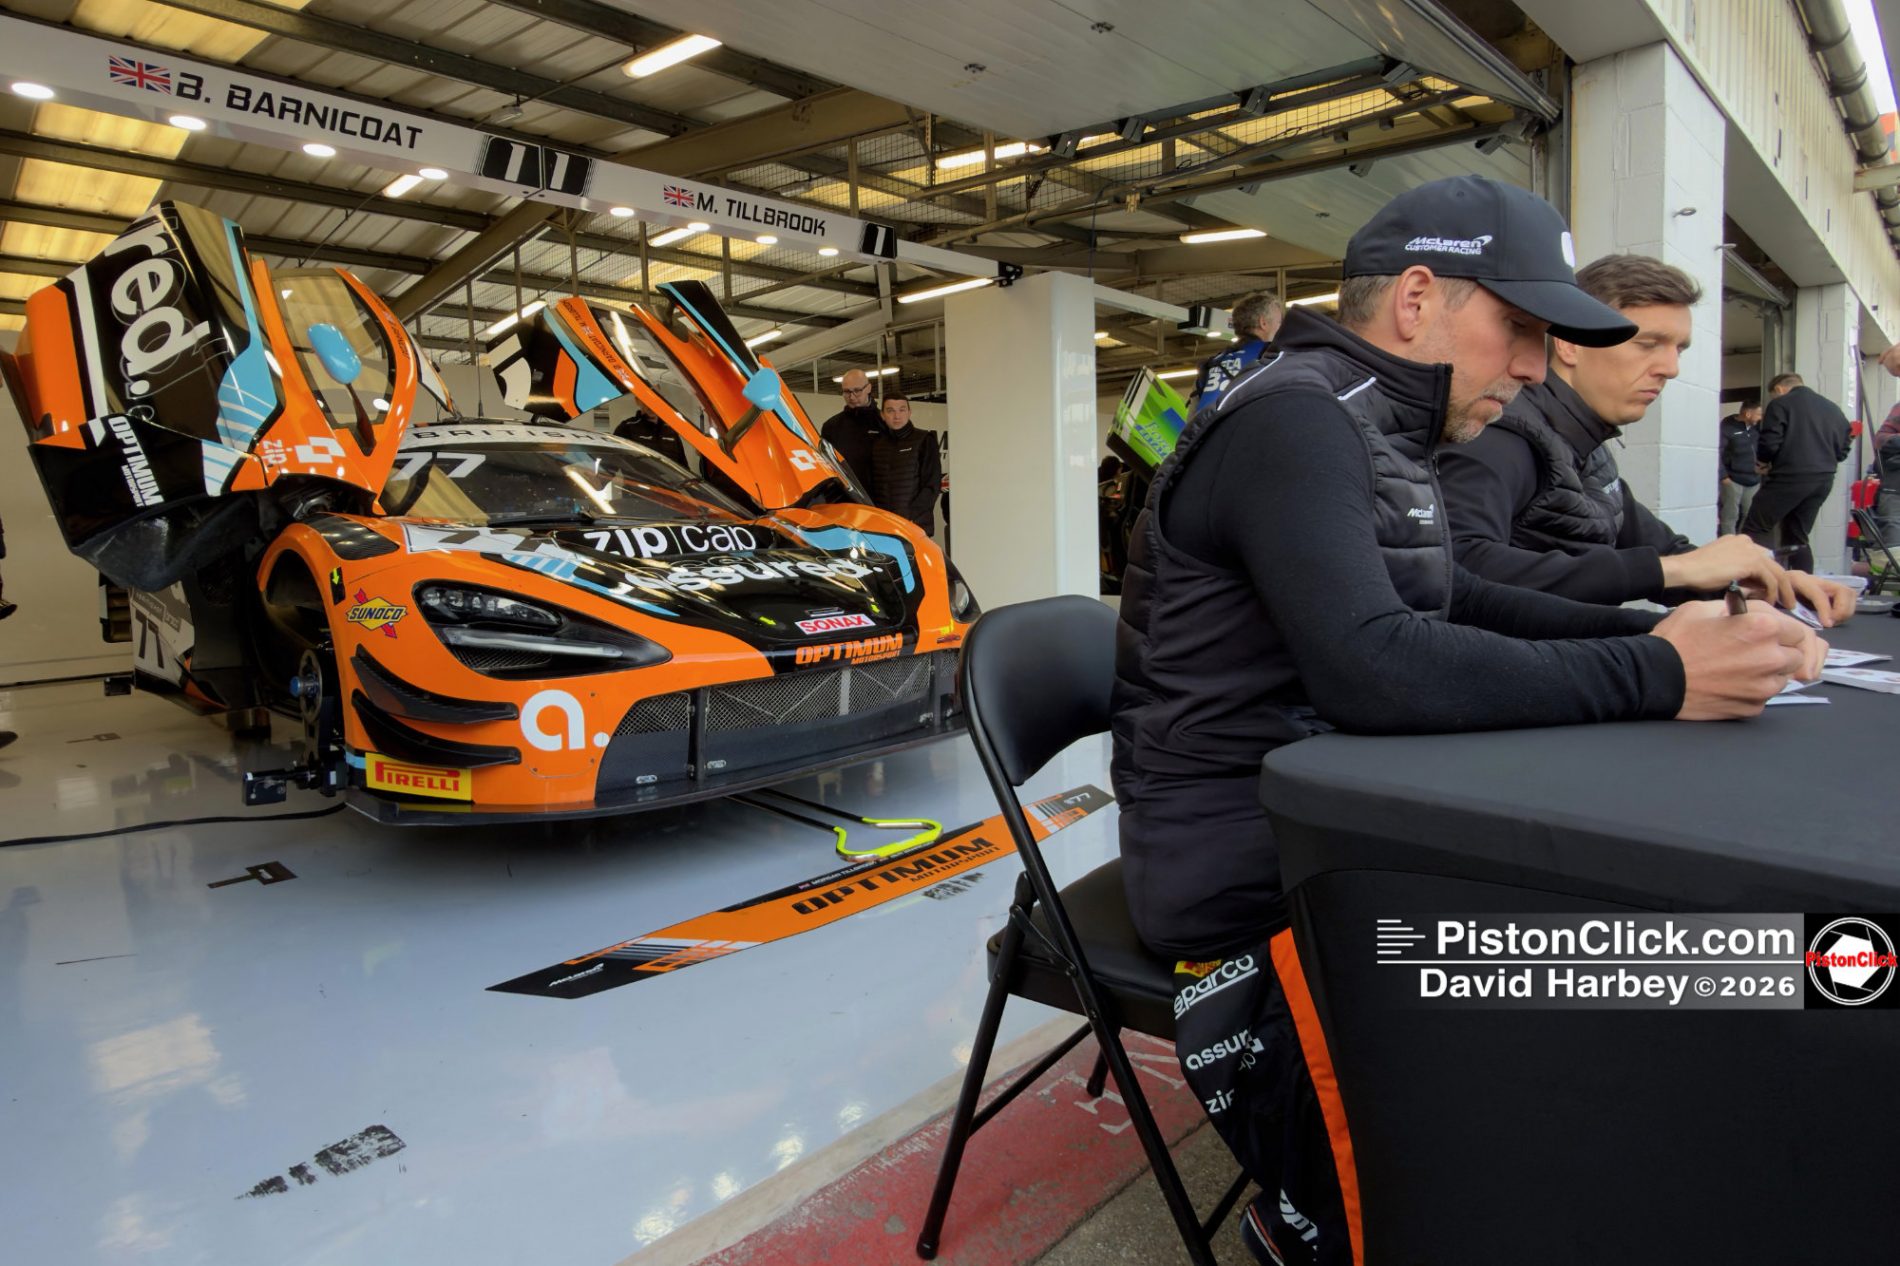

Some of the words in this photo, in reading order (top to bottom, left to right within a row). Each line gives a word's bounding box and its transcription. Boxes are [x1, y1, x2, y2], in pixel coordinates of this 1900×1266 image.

[176, 72, 210, 104] B.
[225, 83, 423, 149] BARNICOAT
[696, 192, 718, 214] M.
[726, 198, 826, 237] TILLBROOK
[1404, 243, 1448, 253] CUSTOMER
[1448, 246, 1482, 256] RACING
[1408, 236, 1484, 249] McLaren
[108, 415, 165, 507] OPTIMUM
[583, 525, 668, 559] zip
[350, 607, 405, 620] SUNOCO
[799, 615, 869, 633] SONAX
[795, 632, 903, 665] OPTIMUM
[851, 650, 901, 665] MOTORSPORT
[375, 760, 460, 792] PIRELLI
[791, 836, 995, 915] OPTIMUM
[909, 846, 1000, 883] MOTORSPORT
[1174, 954, 1254, 1014] sparco
